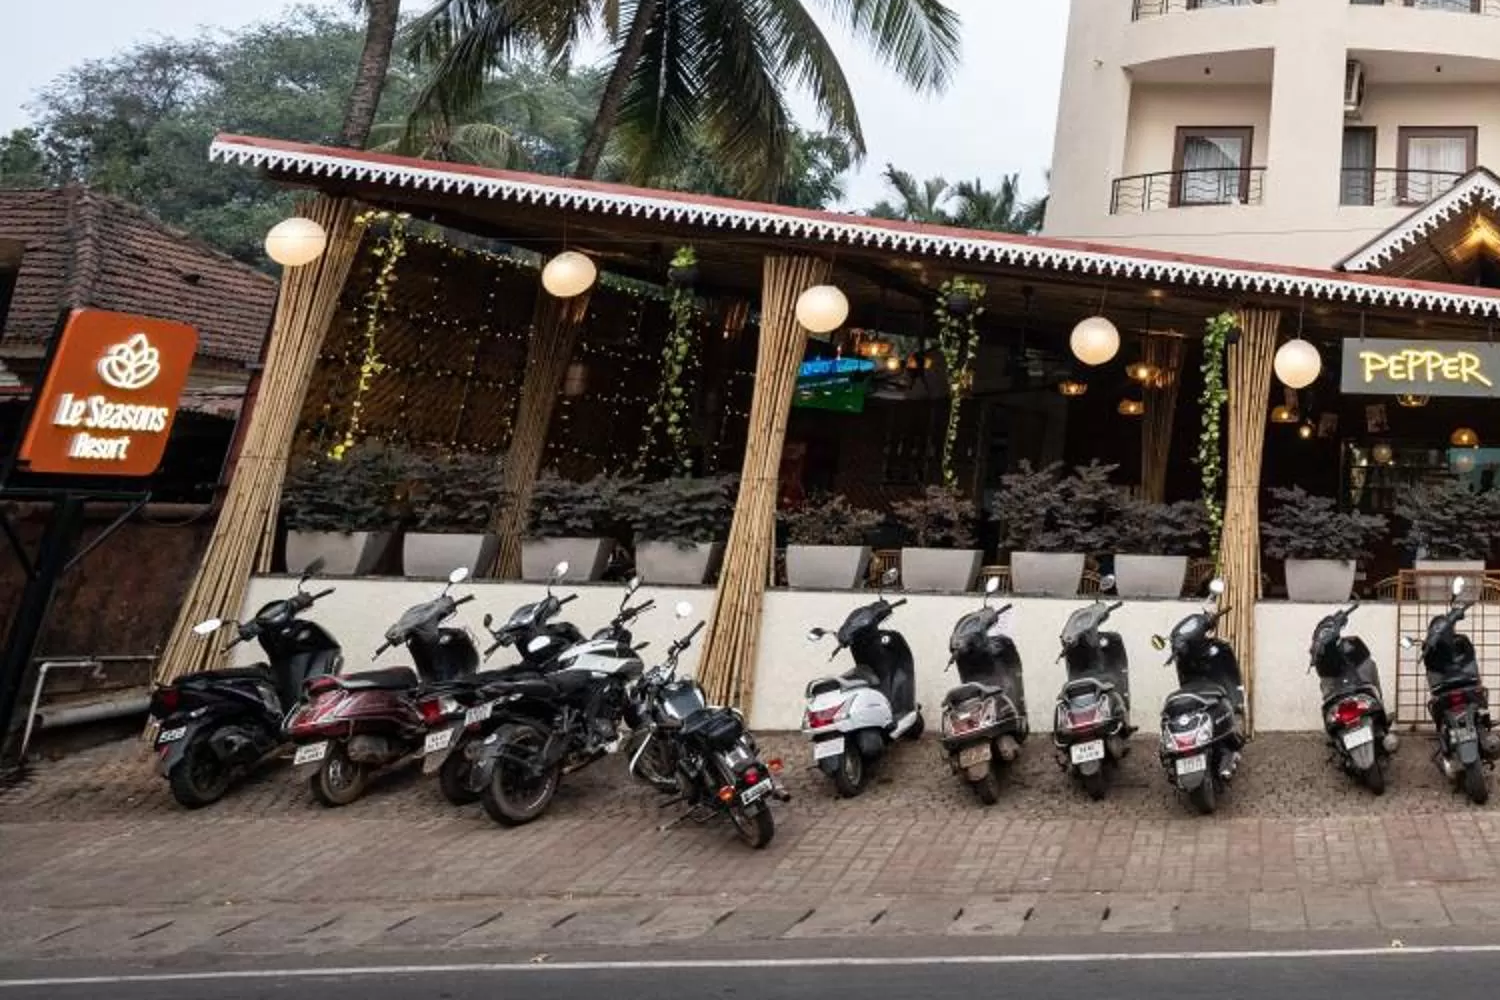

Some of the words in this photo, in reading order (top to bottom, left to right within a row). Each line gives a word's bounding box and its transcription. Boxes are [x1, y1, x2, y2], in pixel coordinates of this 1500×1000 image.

[1359, 349, 1493, 388] PEPPER
[54, 393, 86, 427] Le
[86, 395, 169, 432] Seasons
[69, 432, 131, 460] Resort
